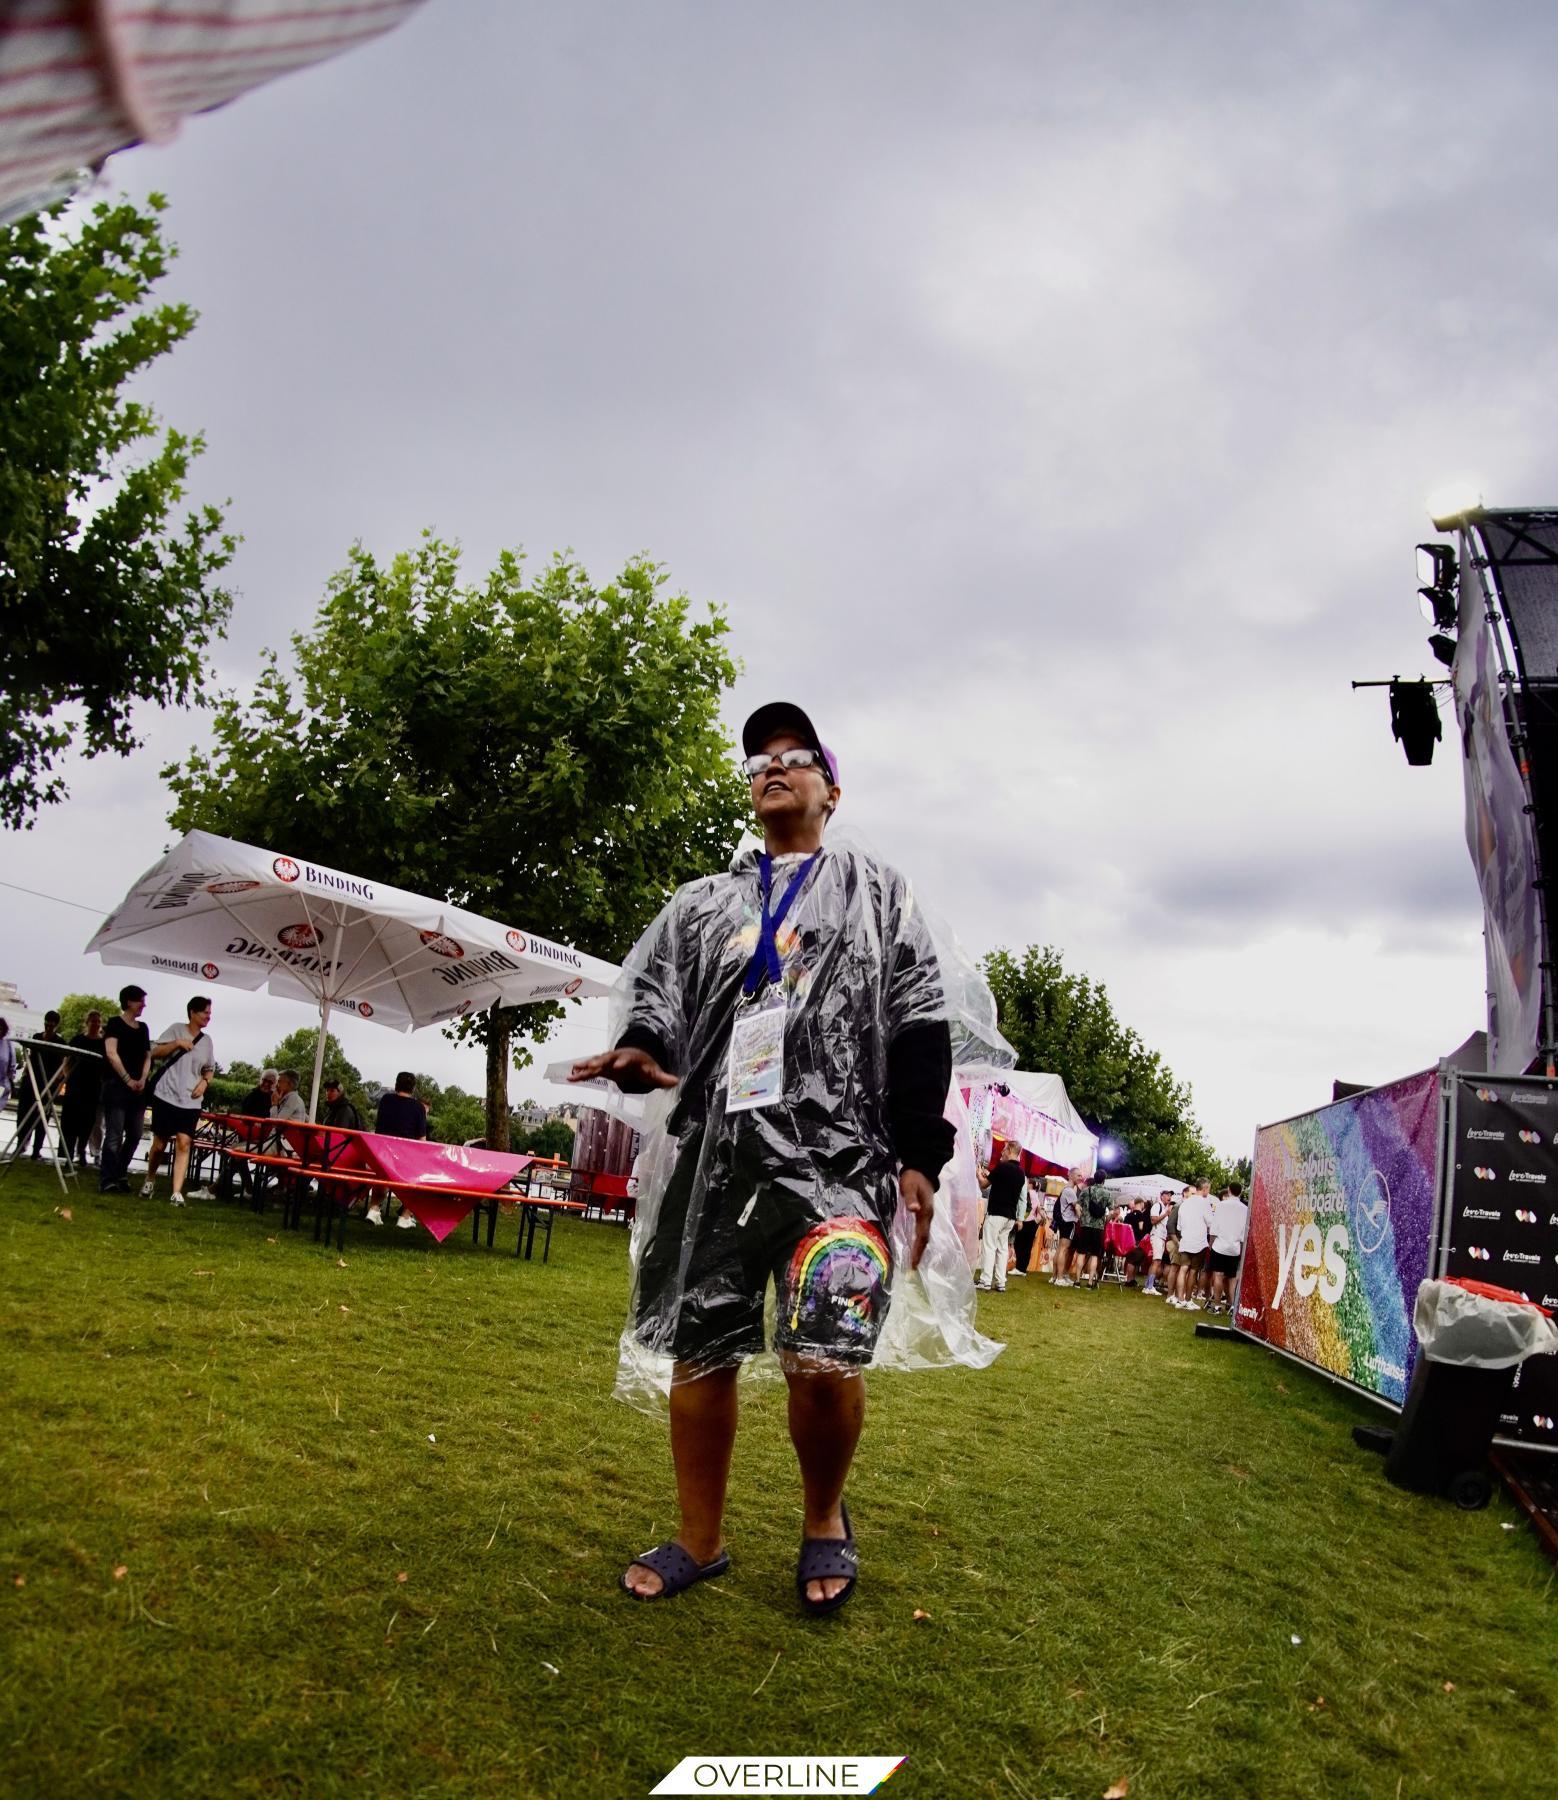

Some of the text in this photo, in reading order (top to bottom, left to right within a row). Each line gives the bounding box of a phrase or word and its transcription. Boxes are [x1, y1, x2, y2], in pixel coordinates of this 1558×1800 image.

[306, 866, 374, 900] BINDING
[530, 938, 582, 969] BINDING
[1295, 1152, 1336, 1180] colours
[1271, 1222, 1350, 1310] yes
[1363, 1350, 1406, 1381] Lufthansa
